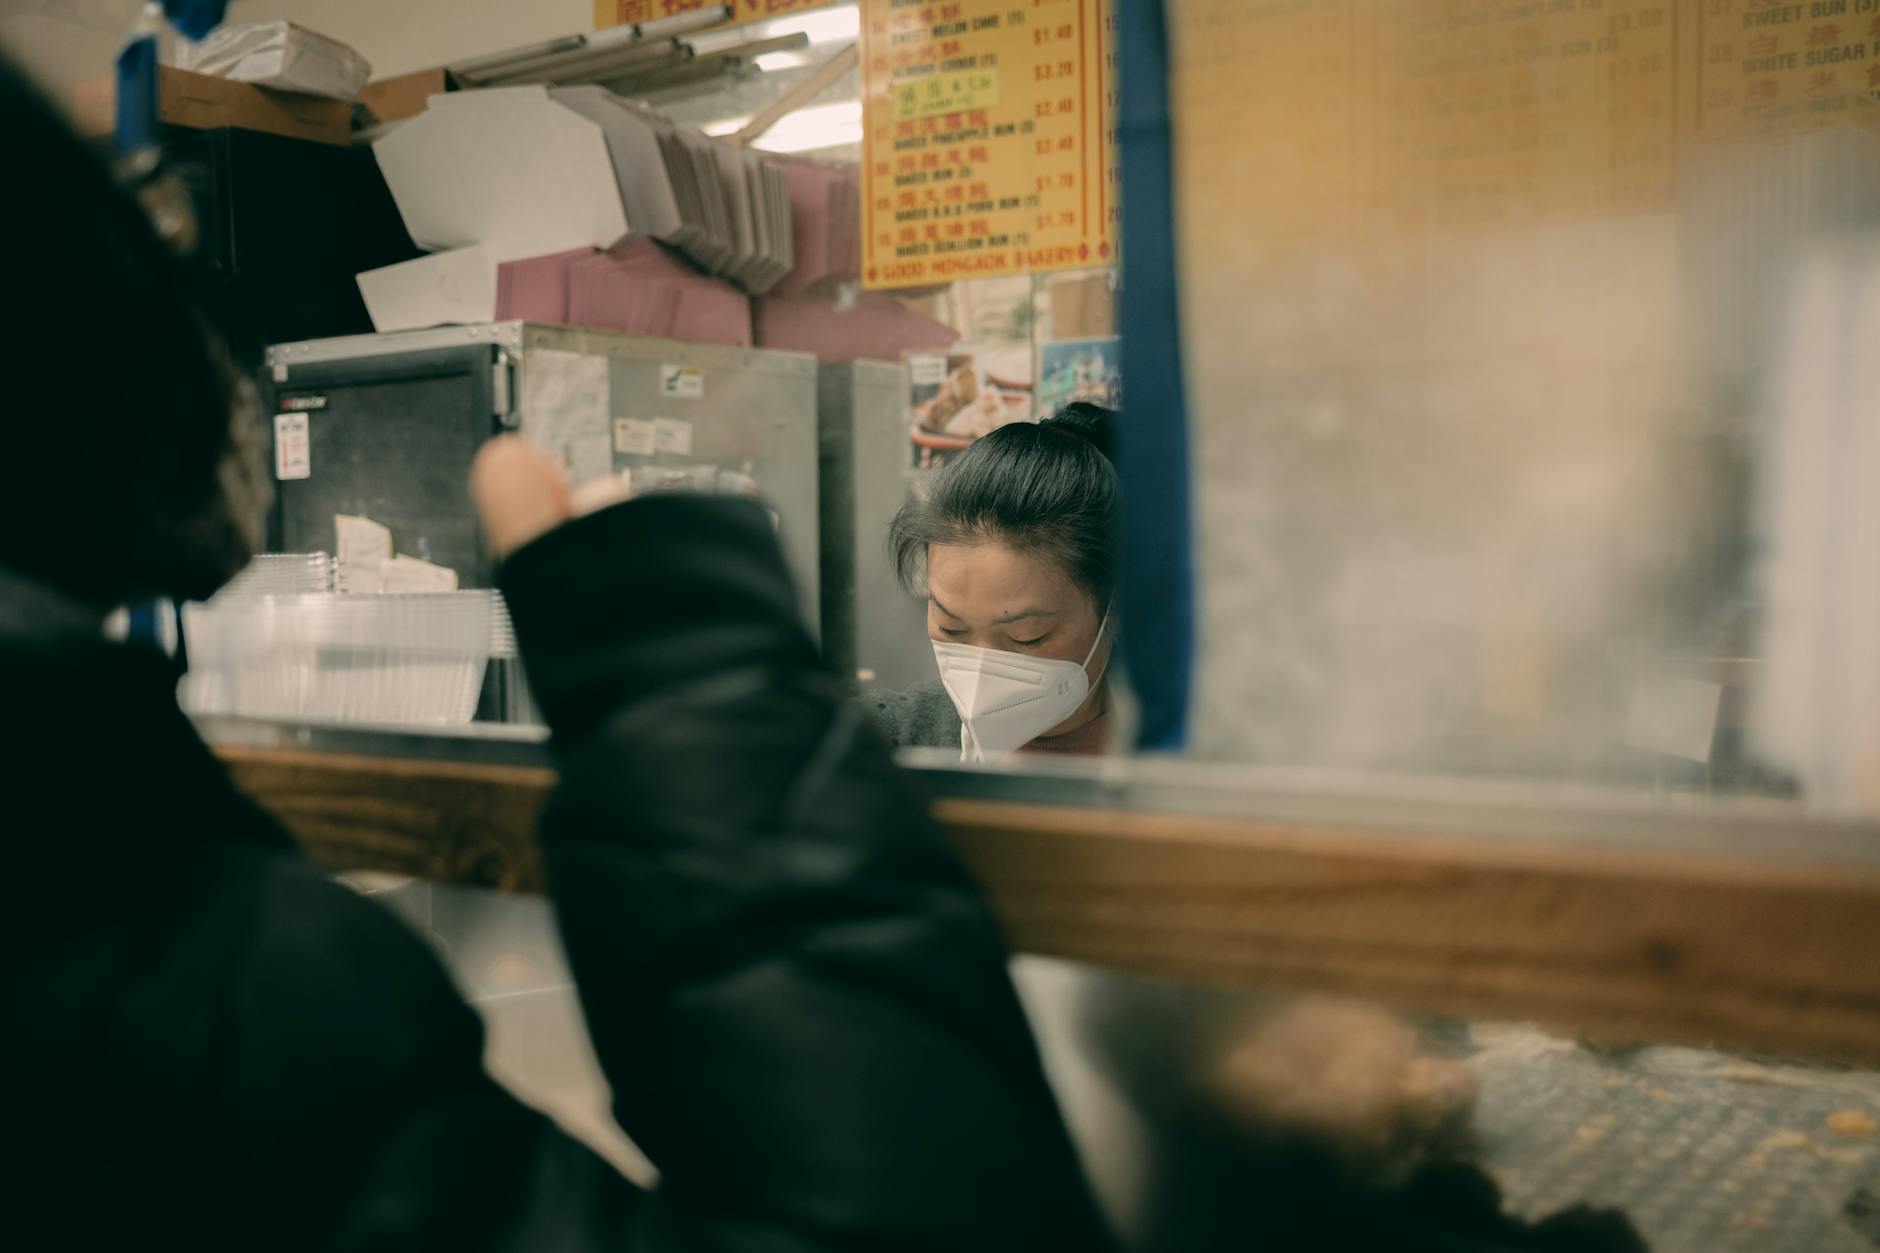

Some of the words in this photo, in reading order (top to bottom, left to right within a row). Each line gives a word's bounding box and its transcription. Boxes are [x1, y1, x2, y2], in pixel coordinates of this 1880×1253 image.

[1608, 7, 1663, 34] $3.00
[1742, 5, 1804, 28] SWEET
[1811, 0, 1846, 18] BUN
[1034, 24, 1072, 45] $1.40
[1742, 52, 1797, 75] WHITE
[1805, 43, 1865, 66] SUGAR
[1035, 98, 1073, 118] $2.40
[882, 261, 926, 278] GOOD
[1014, 245, 1075, 267] BAKERY
